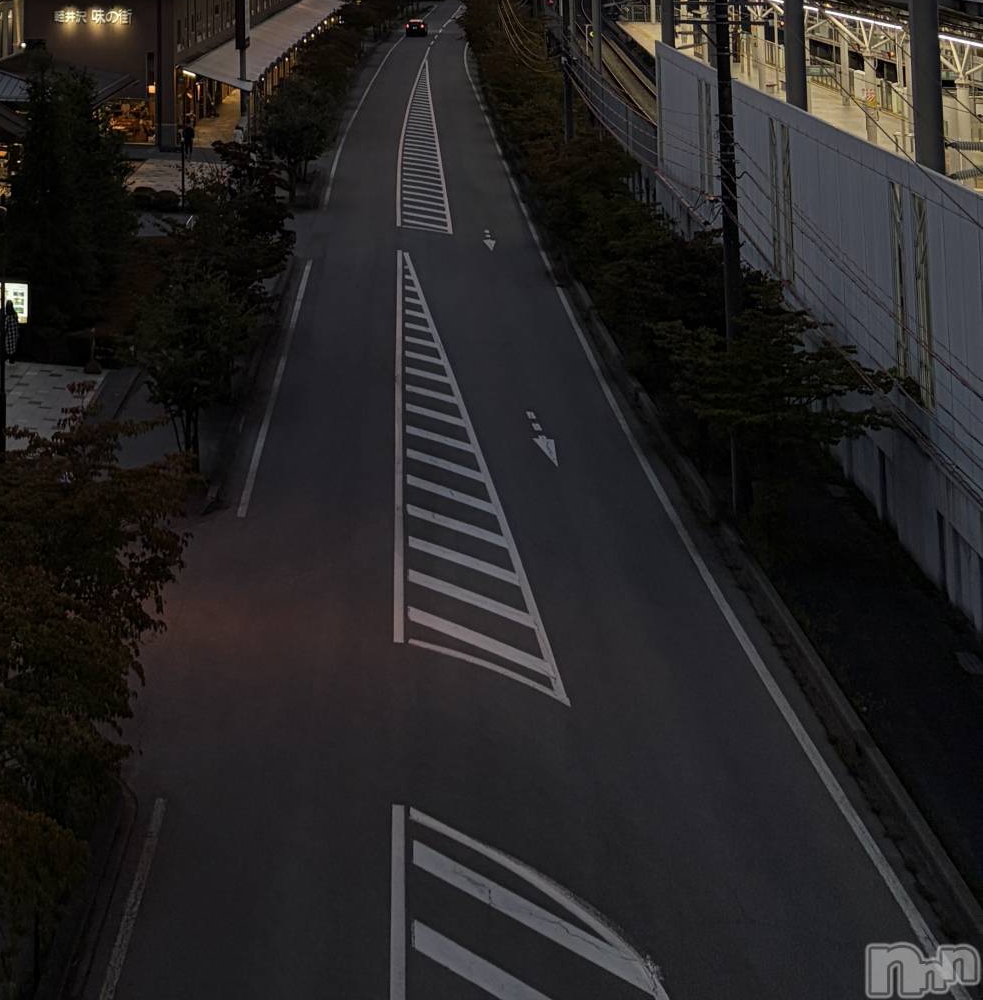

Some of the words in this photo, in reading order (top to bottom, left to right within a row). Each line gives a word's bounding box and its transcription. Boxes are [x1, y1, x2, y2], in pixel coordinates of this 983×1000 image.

[54, 9, 87, 24] 軽井沢
[91, 8, 133, 25] 味の街
